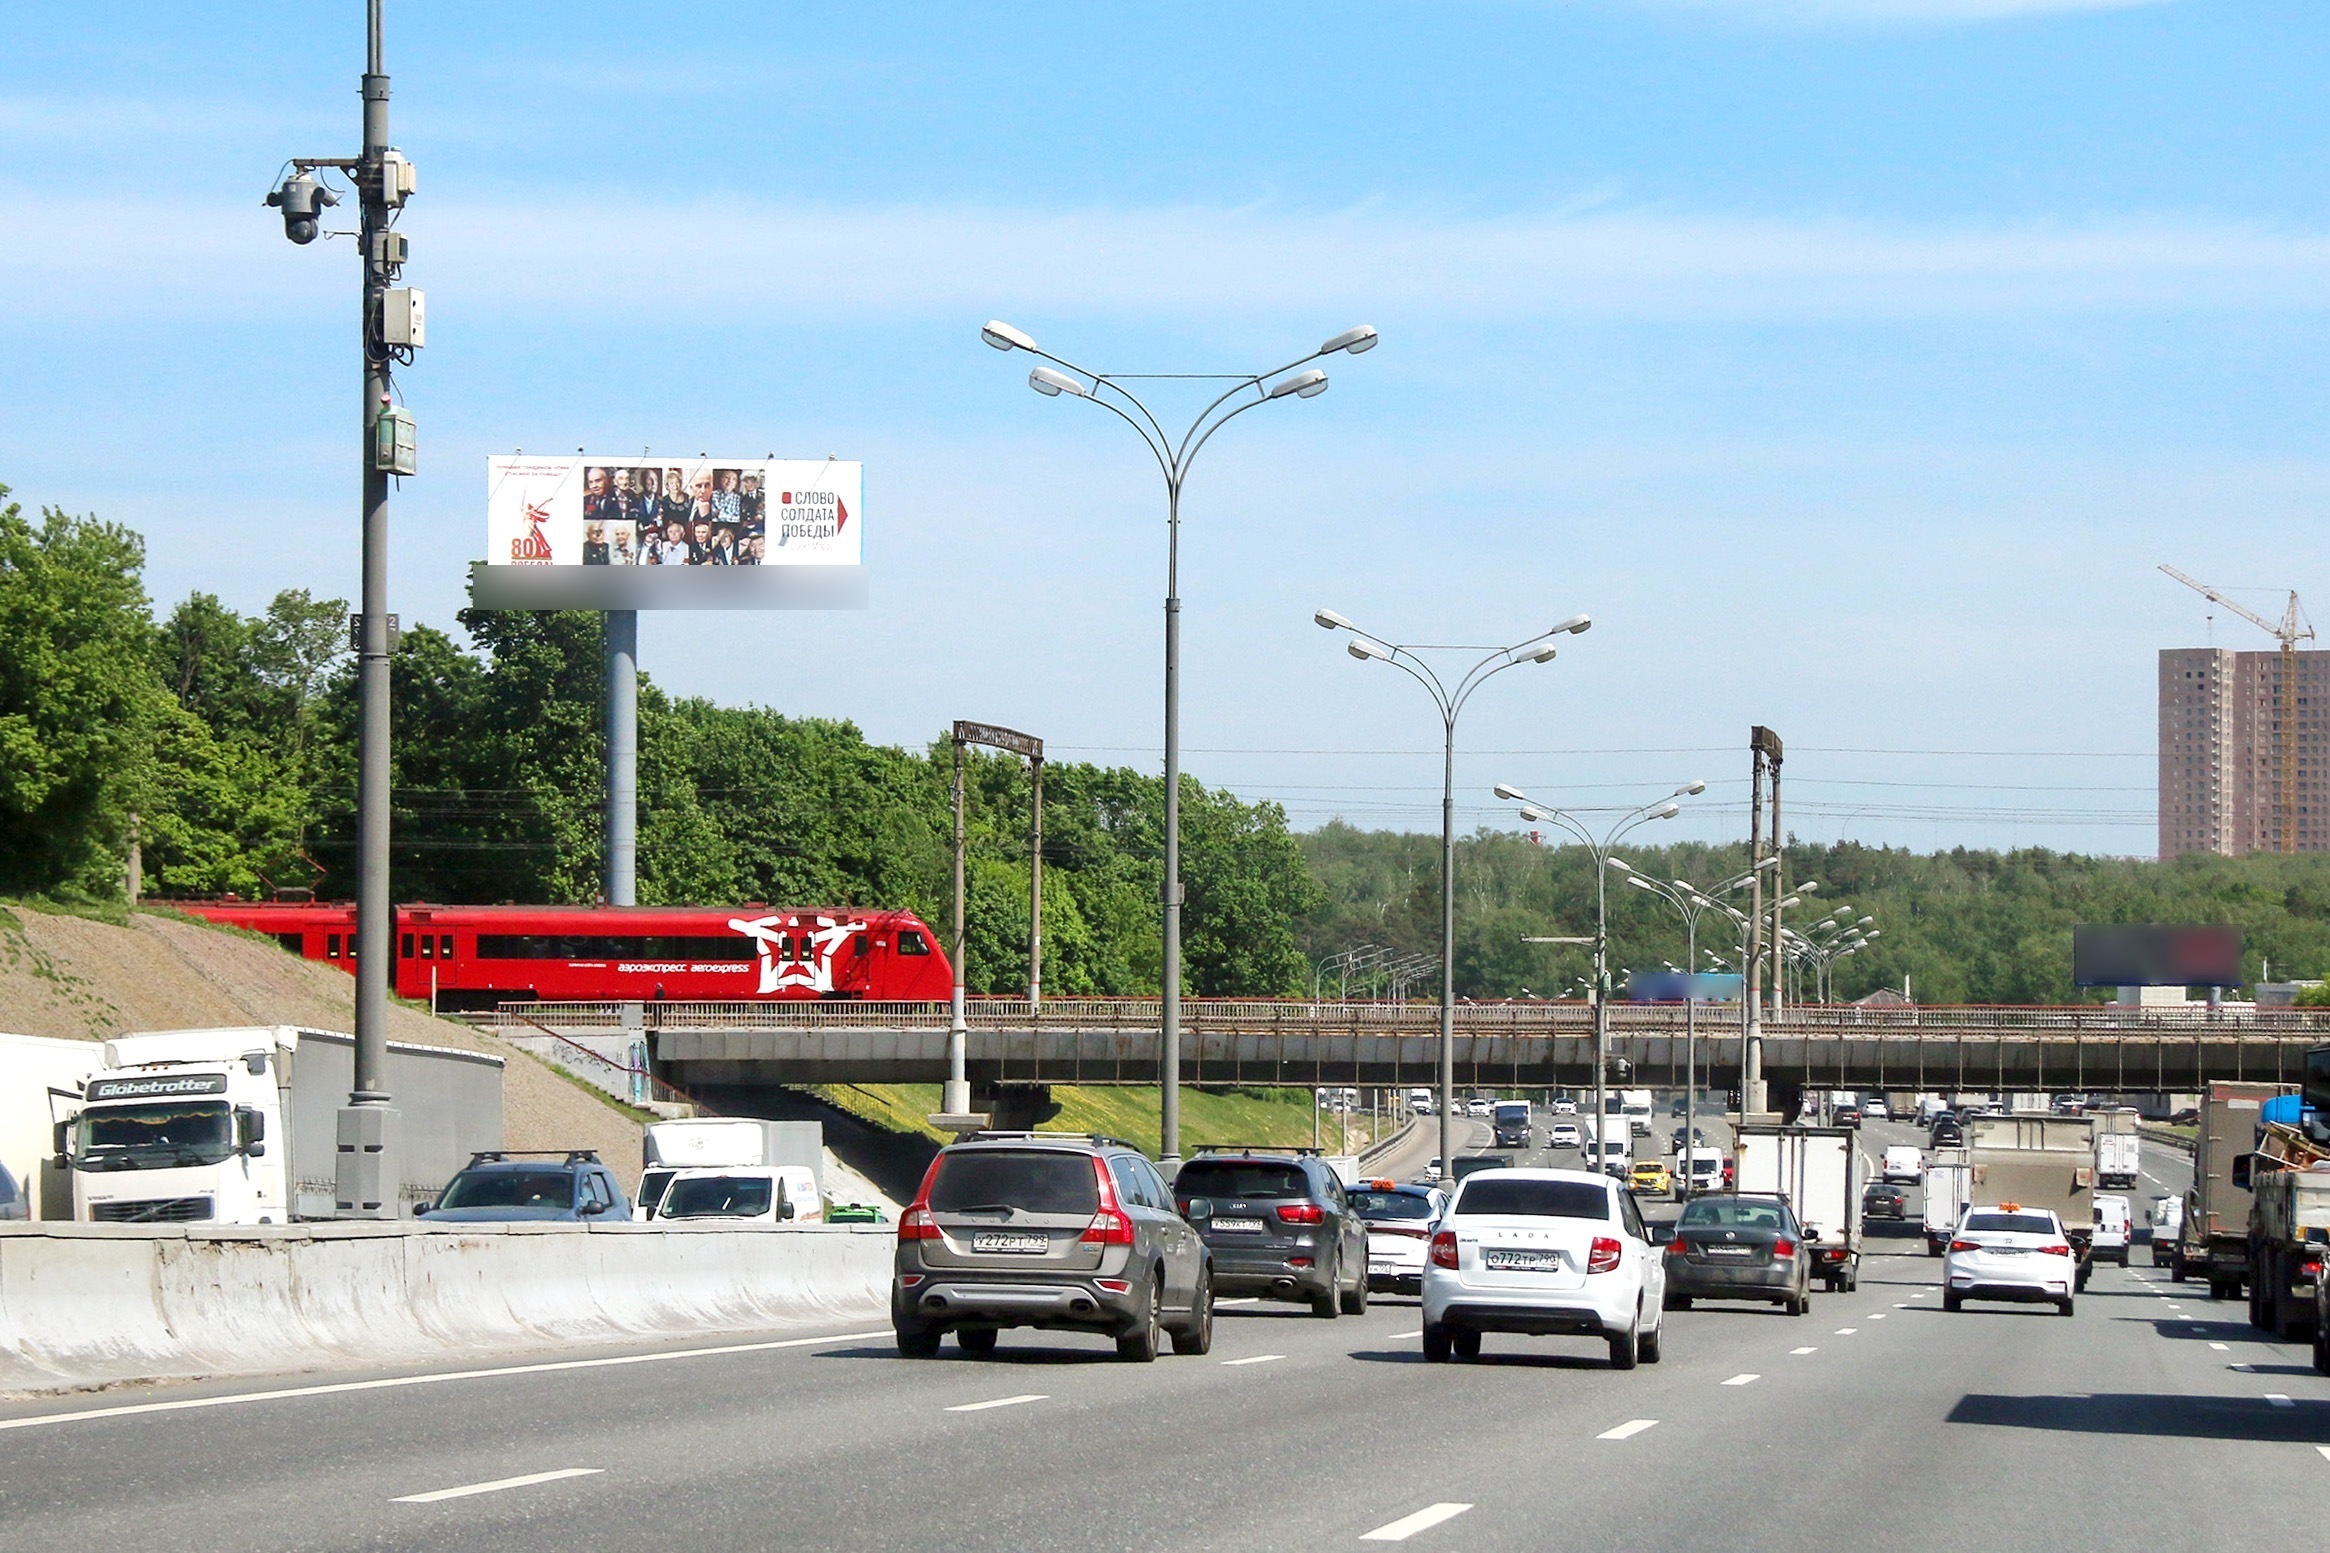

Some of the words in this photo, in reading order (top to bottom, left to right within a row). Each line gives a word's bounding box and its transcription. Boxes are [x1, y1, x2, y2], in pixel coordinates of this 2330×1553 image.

[795, 491, 834, 504] СЛОВО
[781, 508, 834, 523] СОЛДАТА
[781, 524, 834, 539] ПОБЕДЫ
[511, 538, 533, 557] 80
[617, 963, 687, 973] аэроэкспресс
[690, 963, 750, 974] aeroexpress
[98, 1079, 216, 1096] Globetrotter
